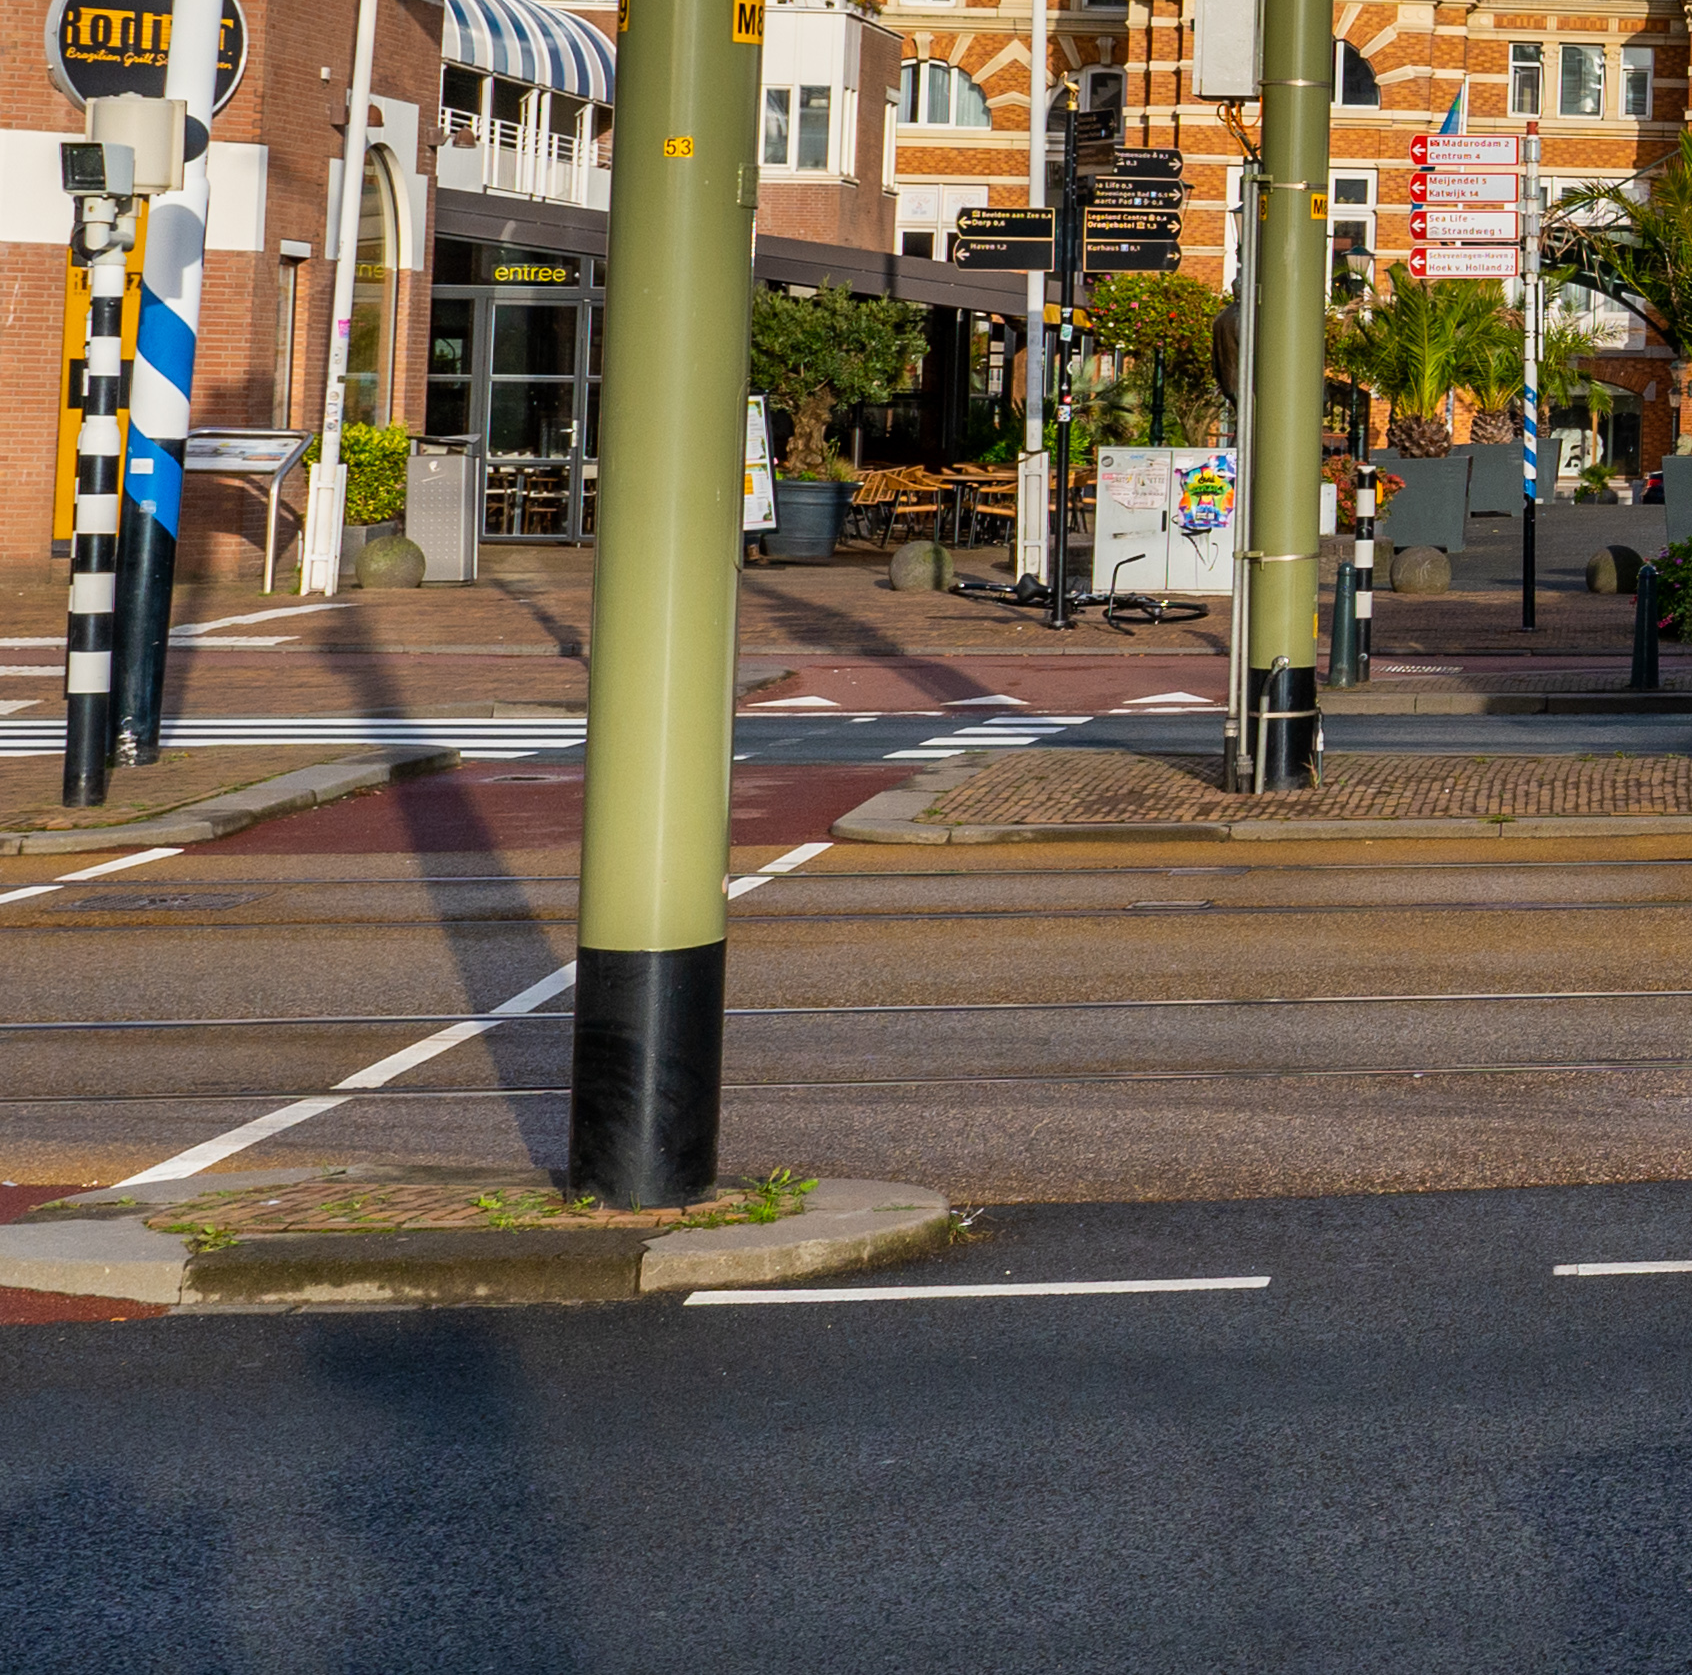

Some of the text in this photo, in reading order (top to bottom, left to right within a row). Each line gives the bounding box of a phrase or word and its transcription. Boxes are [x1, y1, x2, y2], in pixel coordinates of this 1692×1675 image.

[65, 46, 121, 63] Brazilian
[123, 51, 154, 67] Grill
[665, 138, 692, 156] 53
[1442, 139, 1510, 148] Madurodam 2
[1429, 151, 1481, 160] Centrum 4
[1428, 176, 1479, 187] Meijendel
[1428, 189, 1466, 199] Katwijk
[971, 218, 992, 228] Dorp
[1429, 214, 1446, 223] Sea
[1449, 214, 1469, 223] Life
[1441, 226, 1495, 237] Strandweg
[1428, 252, 1508, 261] Scheveningen-Haven
[494, 263, 566, 282] entree
[1428, 264, 1452, 272] Hoek
[1465, 264, 1502, 272] Holland
